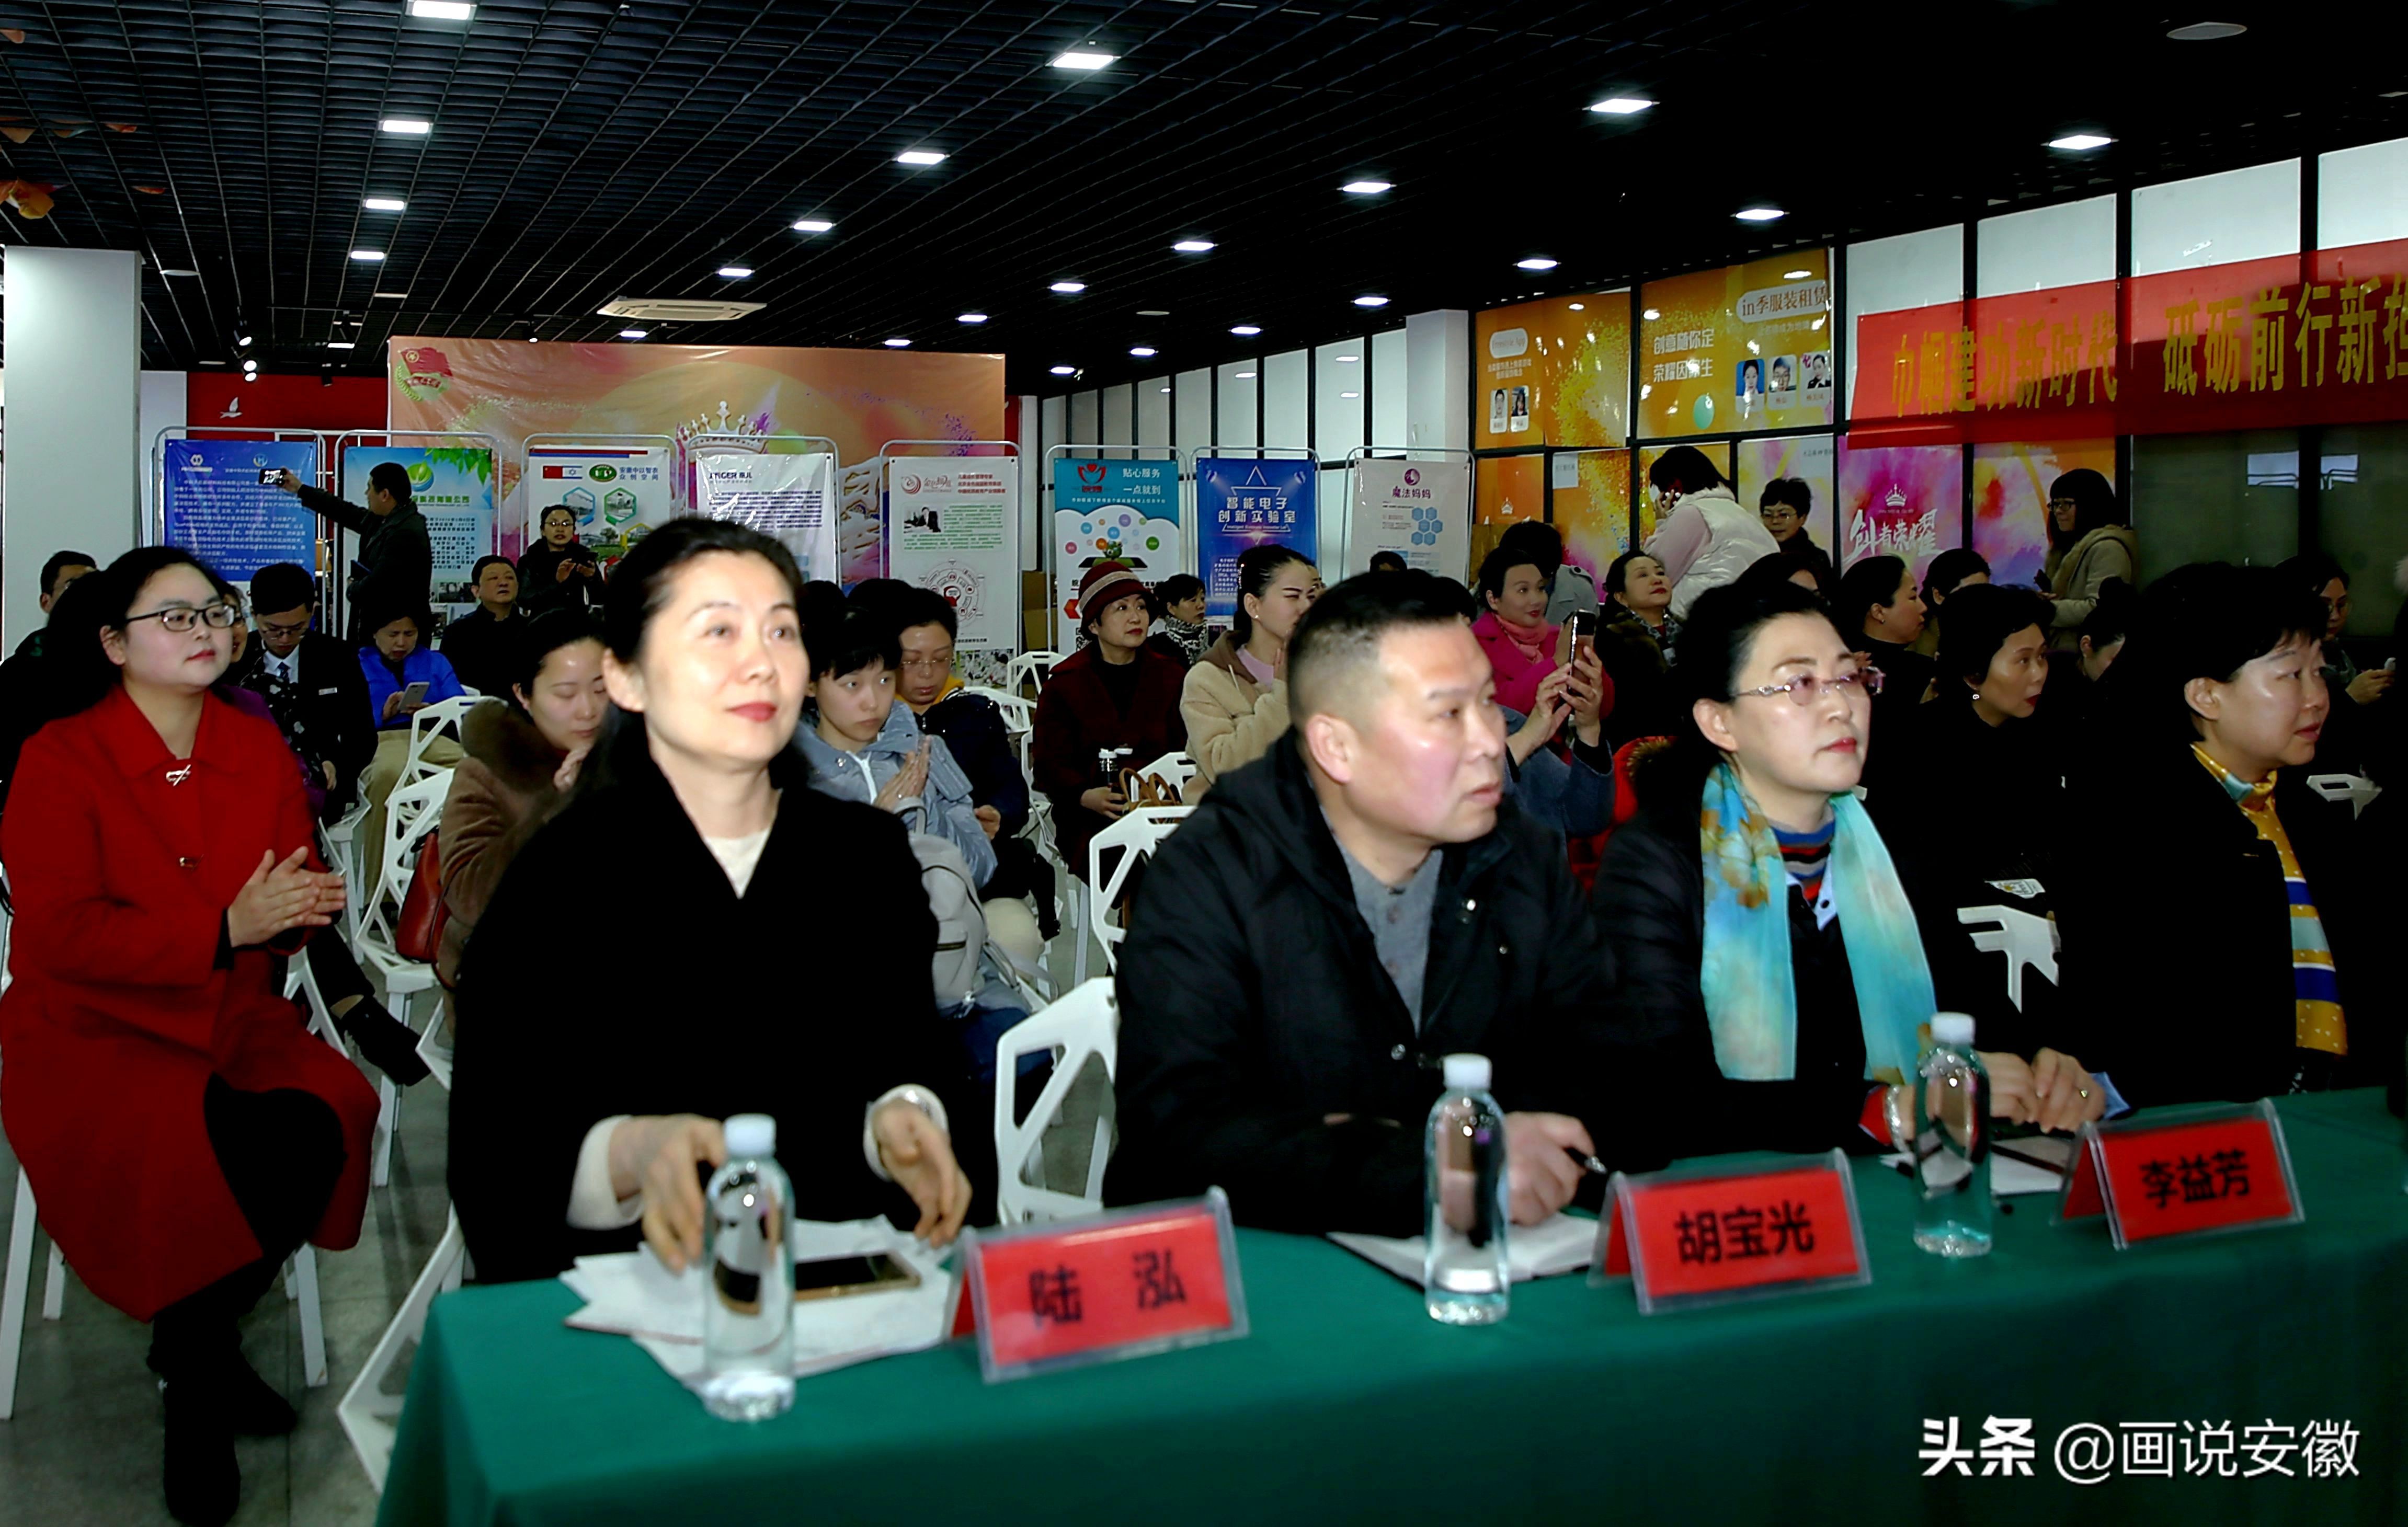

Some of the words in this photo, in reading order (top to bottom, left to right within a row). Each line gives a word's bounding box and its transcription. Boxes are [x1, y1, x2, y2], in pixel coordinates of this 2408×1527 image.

[1653, 328, 1715, 355] 创意随你定
[1891, 309, 2118, 418] 巾帼建功新时代
[1122, 468, 1161, 478] 贴心服务
[1123, 485, 1161, 495] 一点就到
[1392, 486, 1431, 499] 魔法妈妈
[1226, 496, 1288, 510] 智能电子
[1218, 510, 1296, 523] 创新实验室
[2140, 1149, 2251, 1210] 李益芳
[1675, 1200, 1815, 1264] 胡宝光
